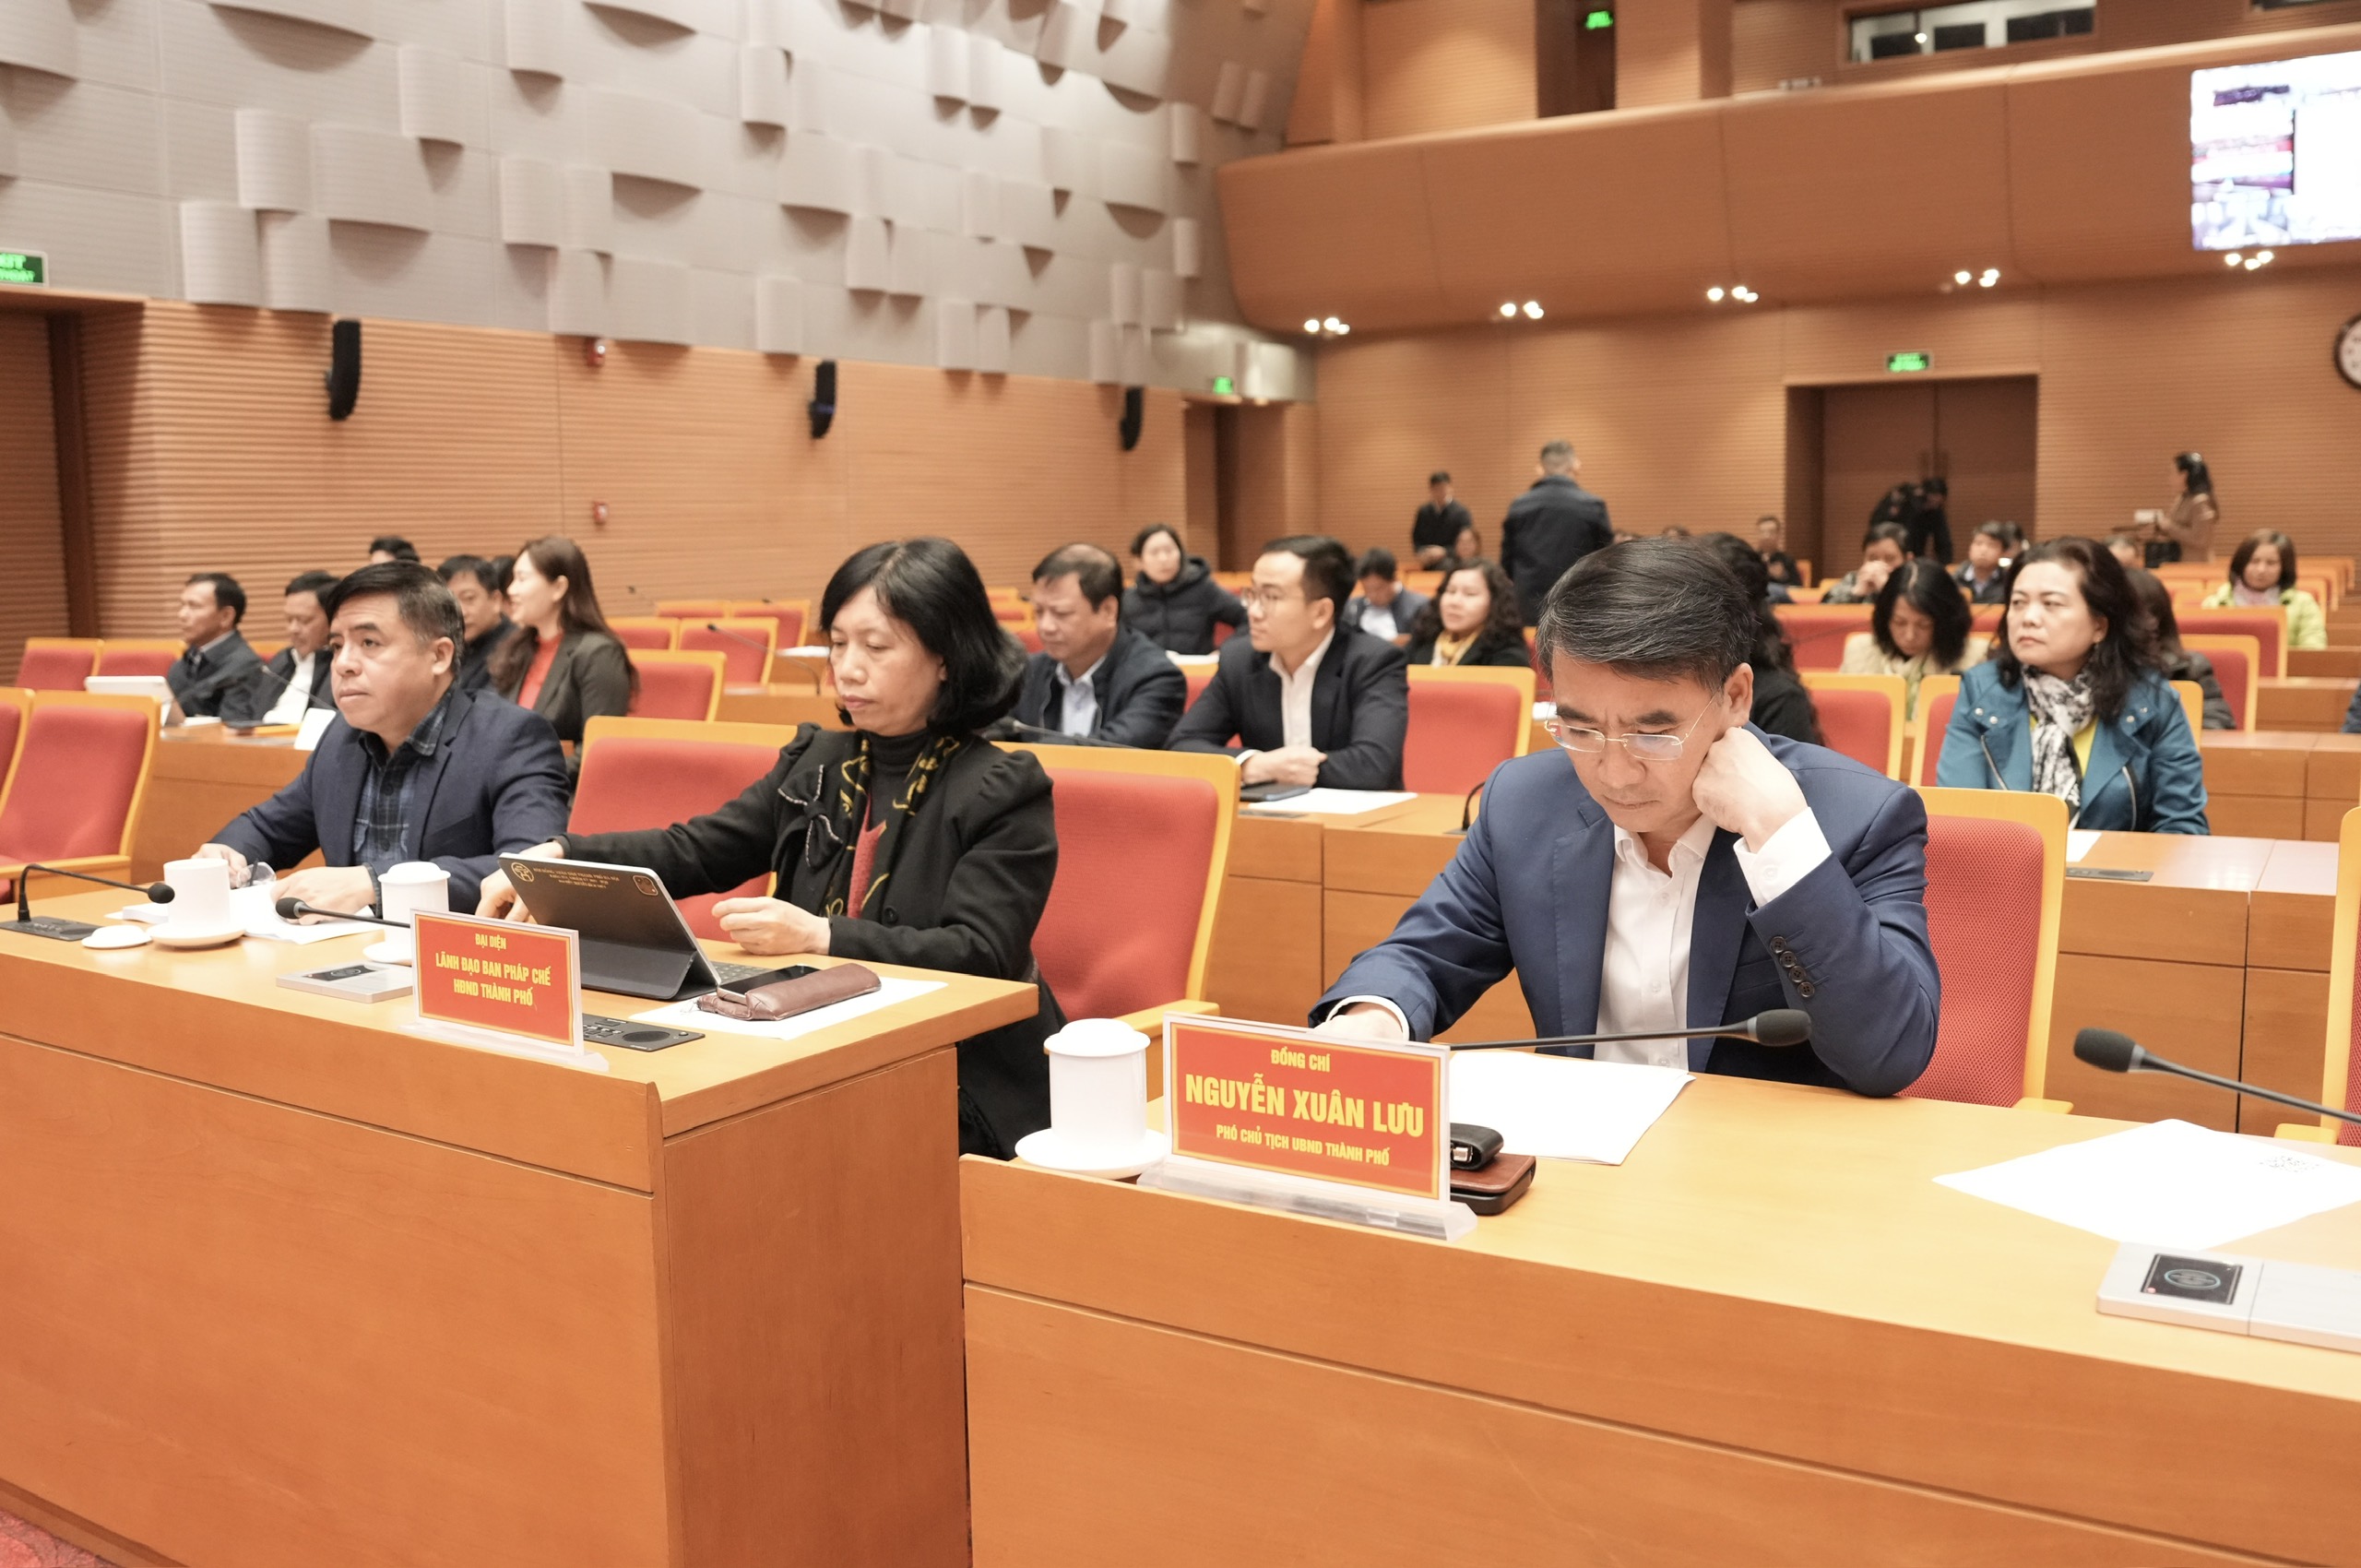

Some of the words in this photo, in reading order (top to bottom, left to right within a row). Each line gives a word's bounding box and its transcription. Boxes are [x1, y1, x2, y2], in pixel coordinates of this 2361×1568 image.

[489, 934, 506, 951] DIỆN
[435, 951, 460, 969] LÃNH
[461, 956, 480, 976] ĐẠO
[482, 960, 502, 978] BAN
[504, 963, 529, 981] PHÁP
[532, 966, 552, 986] CHẾ
[454, 979, 479, 996] HĐND
[481, 982, 511, 1003] THÀNH
[514, 986, 534, 1006] PHỐ
[1309, 1053, 1331, 1073] CHÍ
[1185, 1073, 1285, 1117] NGUYỄN
[1292, 1089, 1364, 1128] XUÂN
[1372, 1100, 1424, 1137] LƯU
[1216, 1124, 1238, 1141] PHÓ
[1240, 1125, 1263, 1145] CHỦ
[1265, 1133, 1289, 1149] TỊCH
[1291, 1138, 1323, 1154] UBND
[1325, 1142, 1363, 1162] THÀNH
[1365, 1146, 1390, 1166] PHỐ
